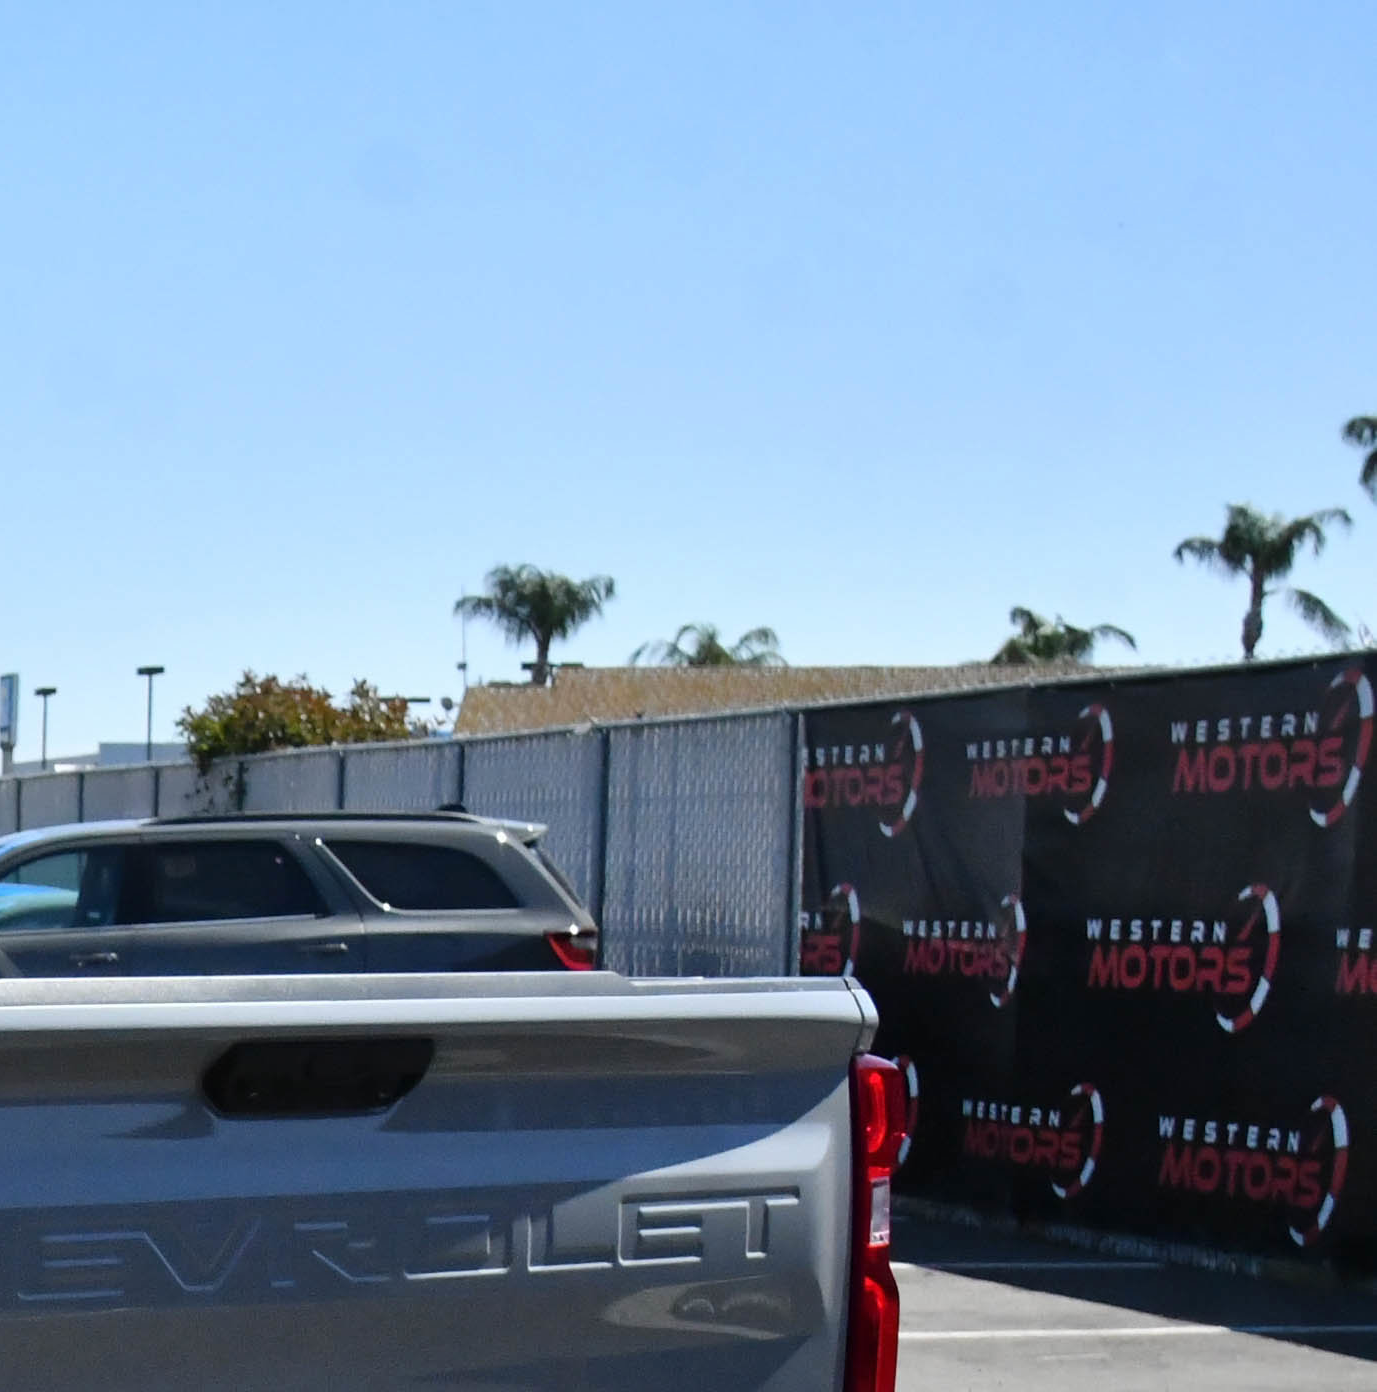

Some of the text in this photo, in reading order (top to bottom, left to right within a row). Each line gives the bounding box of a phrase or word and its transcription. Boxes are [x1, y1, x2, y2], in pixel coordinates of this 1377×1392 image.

[966, 735, 1072, 760] WESTERN
[1171, 711, 1320, 744] WESTERN
[969, 754, 1092, 800] MOTORS
[1172, 736, 1344, 792] MOTORS
[803, 763, 903, 808] OTORS
[902, 919, 996, 940] WESTERN
[1086, 918, 1227, 943] WESTERN
[903, 936, 1010, 976] MOTORS
[1088, 944, 1253, 994] MOTORS
[962, 1098, 1061, 1127] WESTERN
[962, 1122, 1083, 1170] MOTORS
[1159, 1114, 1302, 1153] WESTERN
[1159, 1143, 1322, 1207] MOTORS
